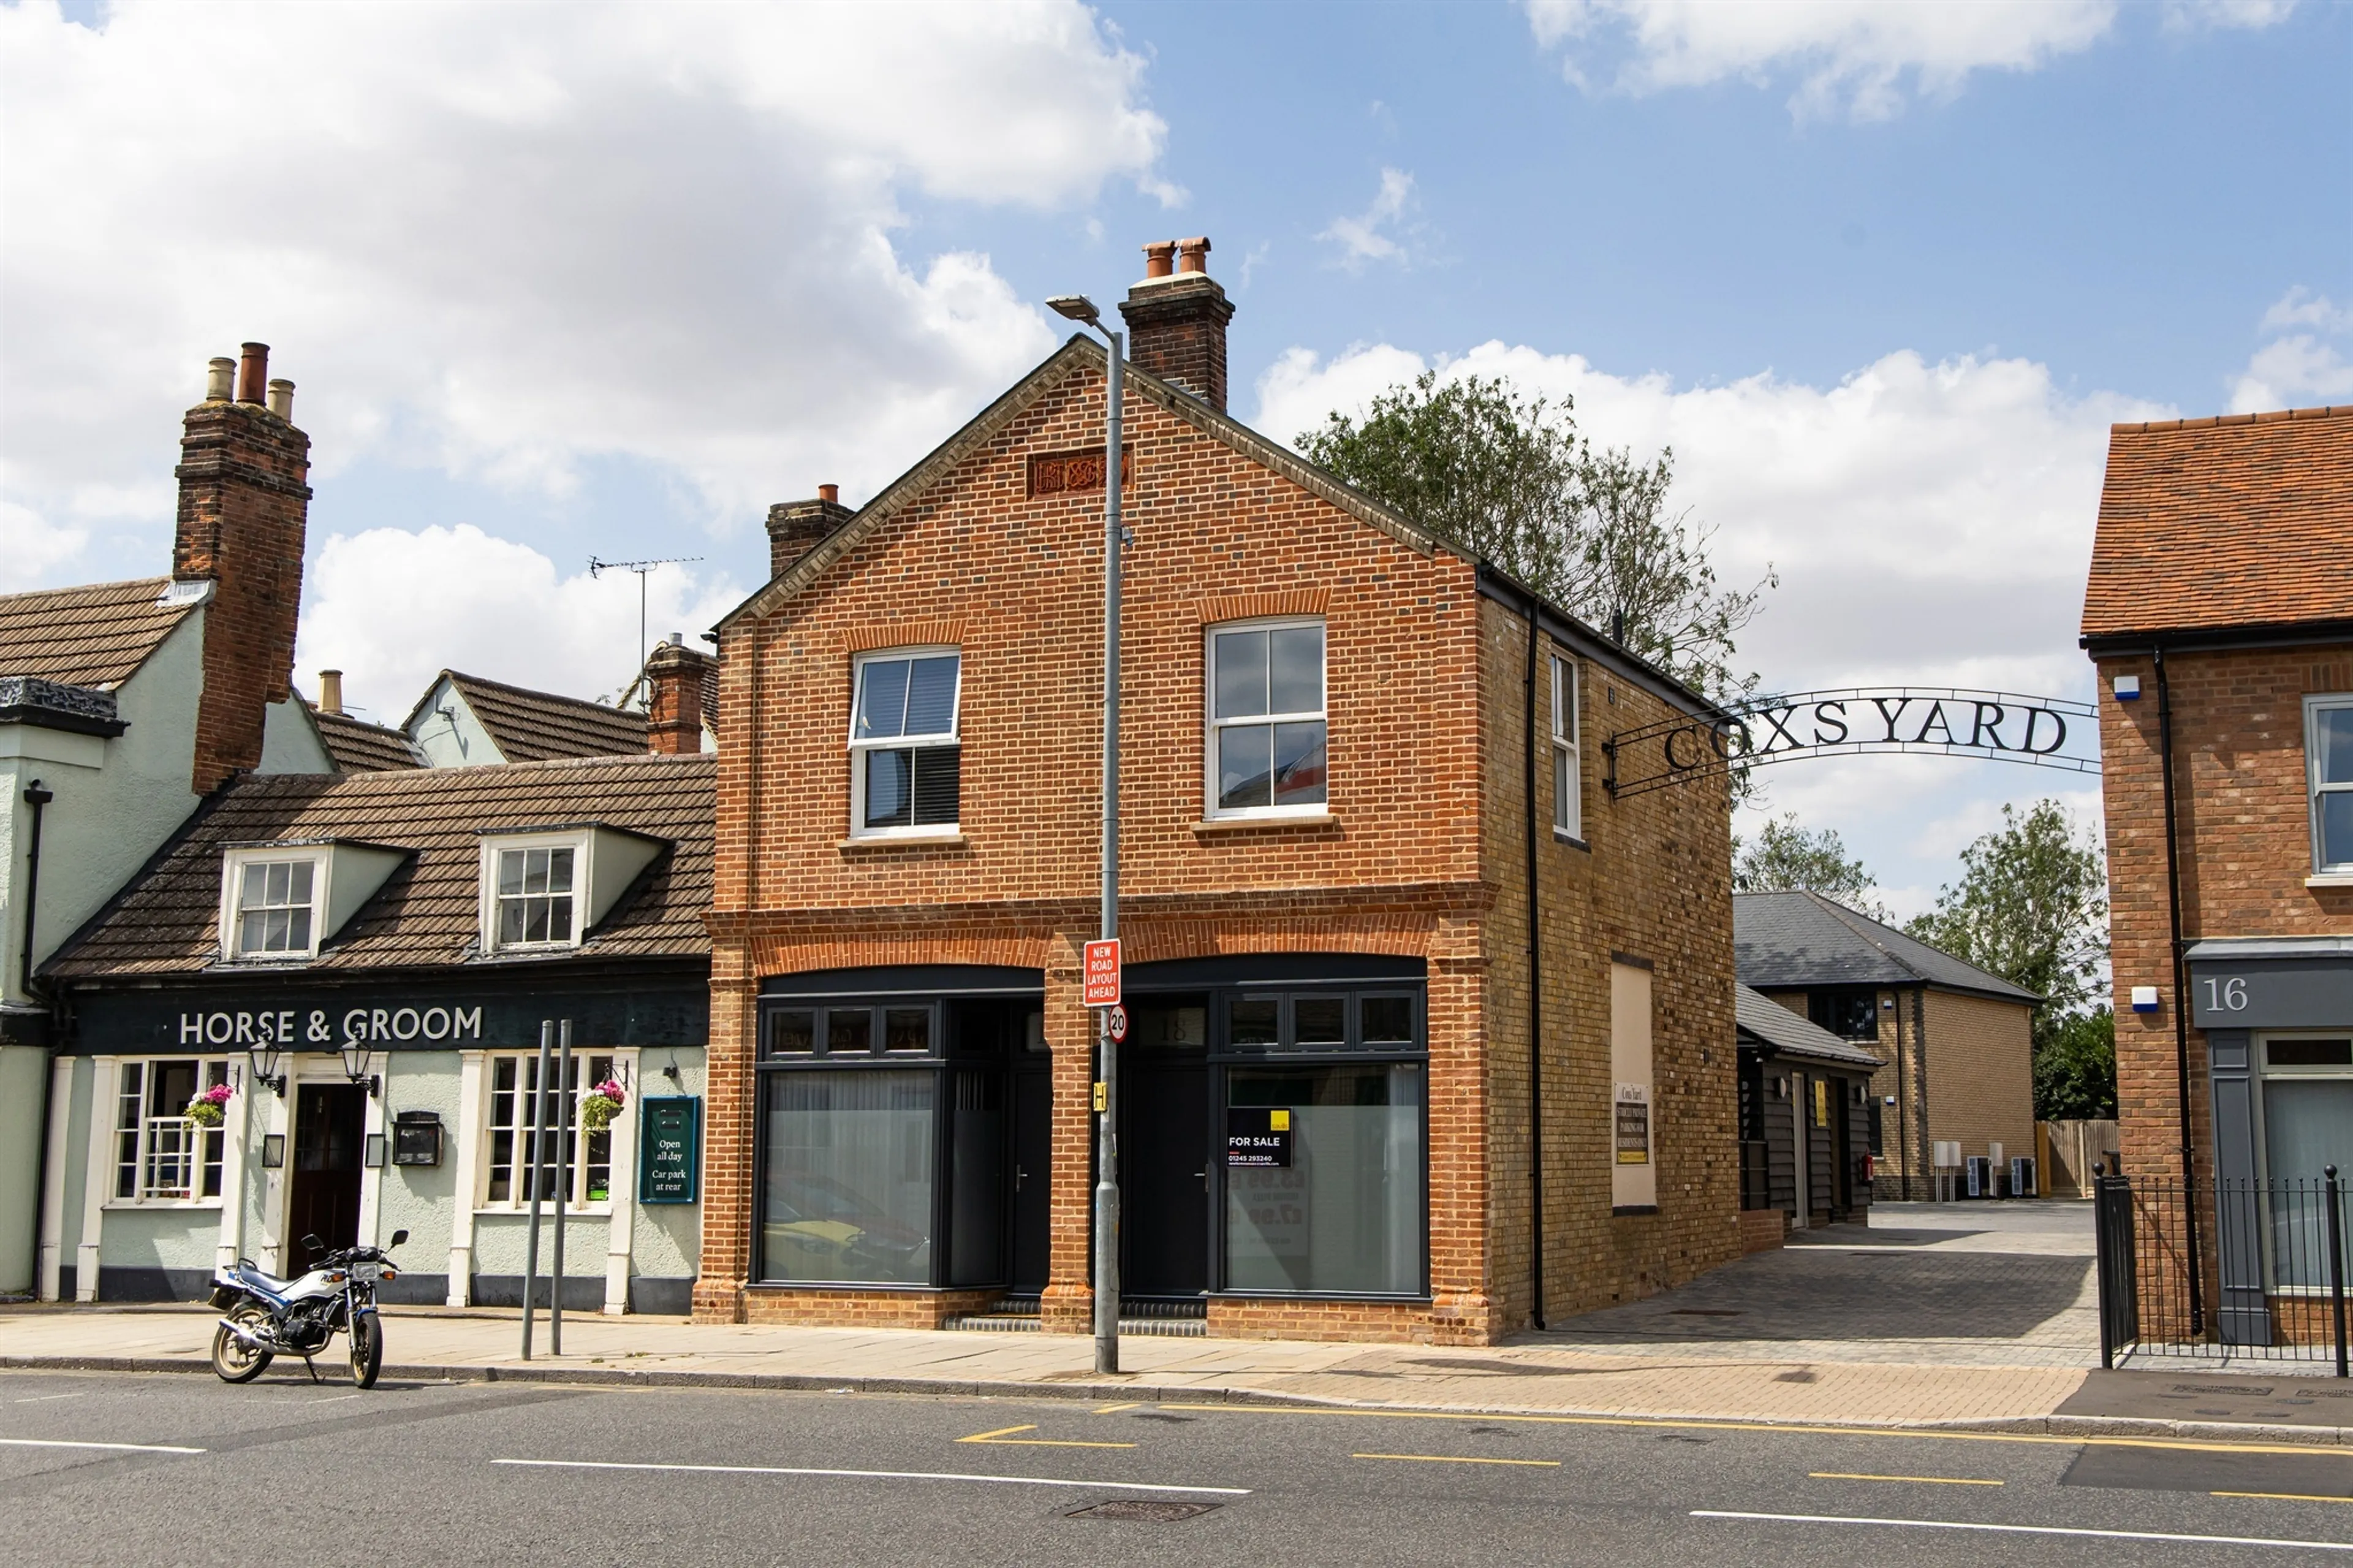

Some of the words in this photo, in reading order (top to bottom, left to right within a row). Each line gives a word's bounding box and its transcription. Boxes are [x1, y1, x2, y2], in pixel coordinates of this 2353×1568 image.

[1664, 702, 1849, 770] COXS
[1871, 698, 2067, 754] YARD
[1093, 946, 1111, 958] NEW
[1091, 960, 1113, 972] ROAD
[1088, 972, 1117, 986] LAYOUT
[1088, 986, 1115, 999] AHEAD
[2203, 977, 2249, 1011] 16
[180, 1010, 296, 1044] HORSE
[306, 1009, 331, 1042] &
[343, 1006, 483, 1042] GROOM
[1112, 1015, 1124, 1031] 20
[1160, 1017, 1186, 1041] 18
[659, 1140, 681, 1150] Open
[1229, 1137, 1251, 1146] FOR
[1253, 1137, 1280, 1146] SALE
[657, 1151, 667, 1161] all
[668, 1151, 683, 1162] day
[652, 1170, 667, 1178] Car
[668, 1169, 686, 1181] park
